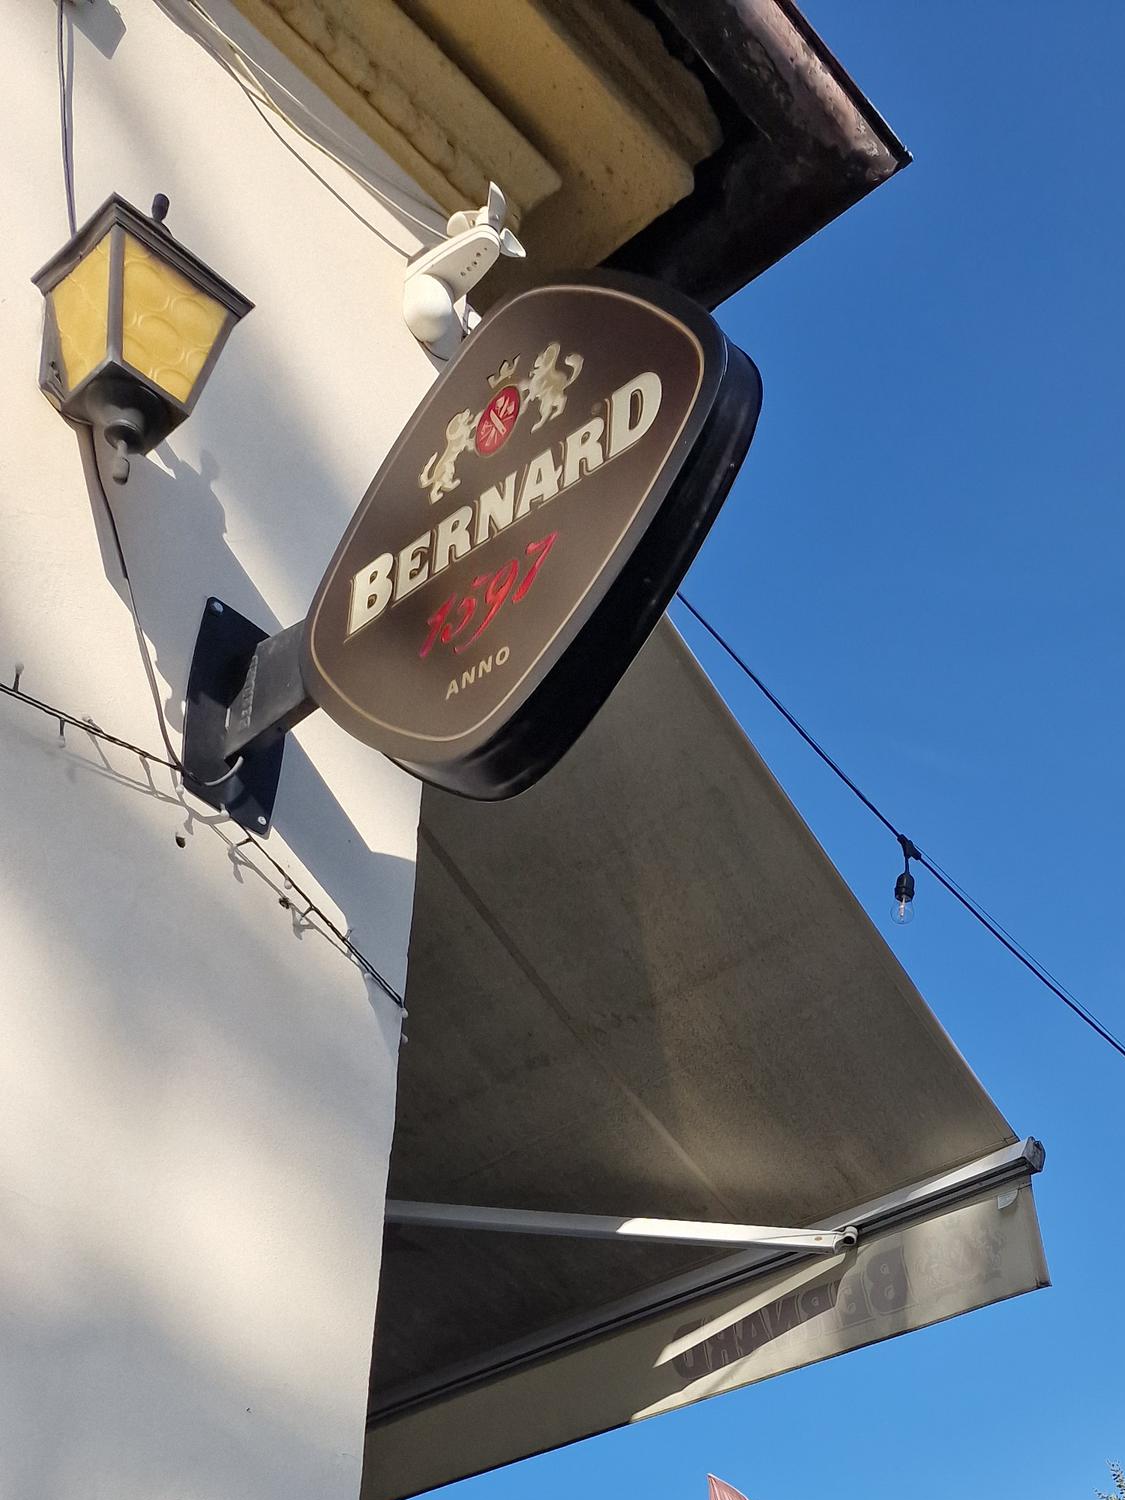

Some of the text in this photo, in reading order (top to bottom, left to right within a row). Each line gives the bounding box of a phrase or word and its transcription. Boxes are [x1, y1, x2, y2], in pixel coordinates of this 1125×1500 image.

[346, 370, 664, 638] BERNARD
[419, 530, 559, 658] 1597
[445, 646, 511, 700] ANNO
